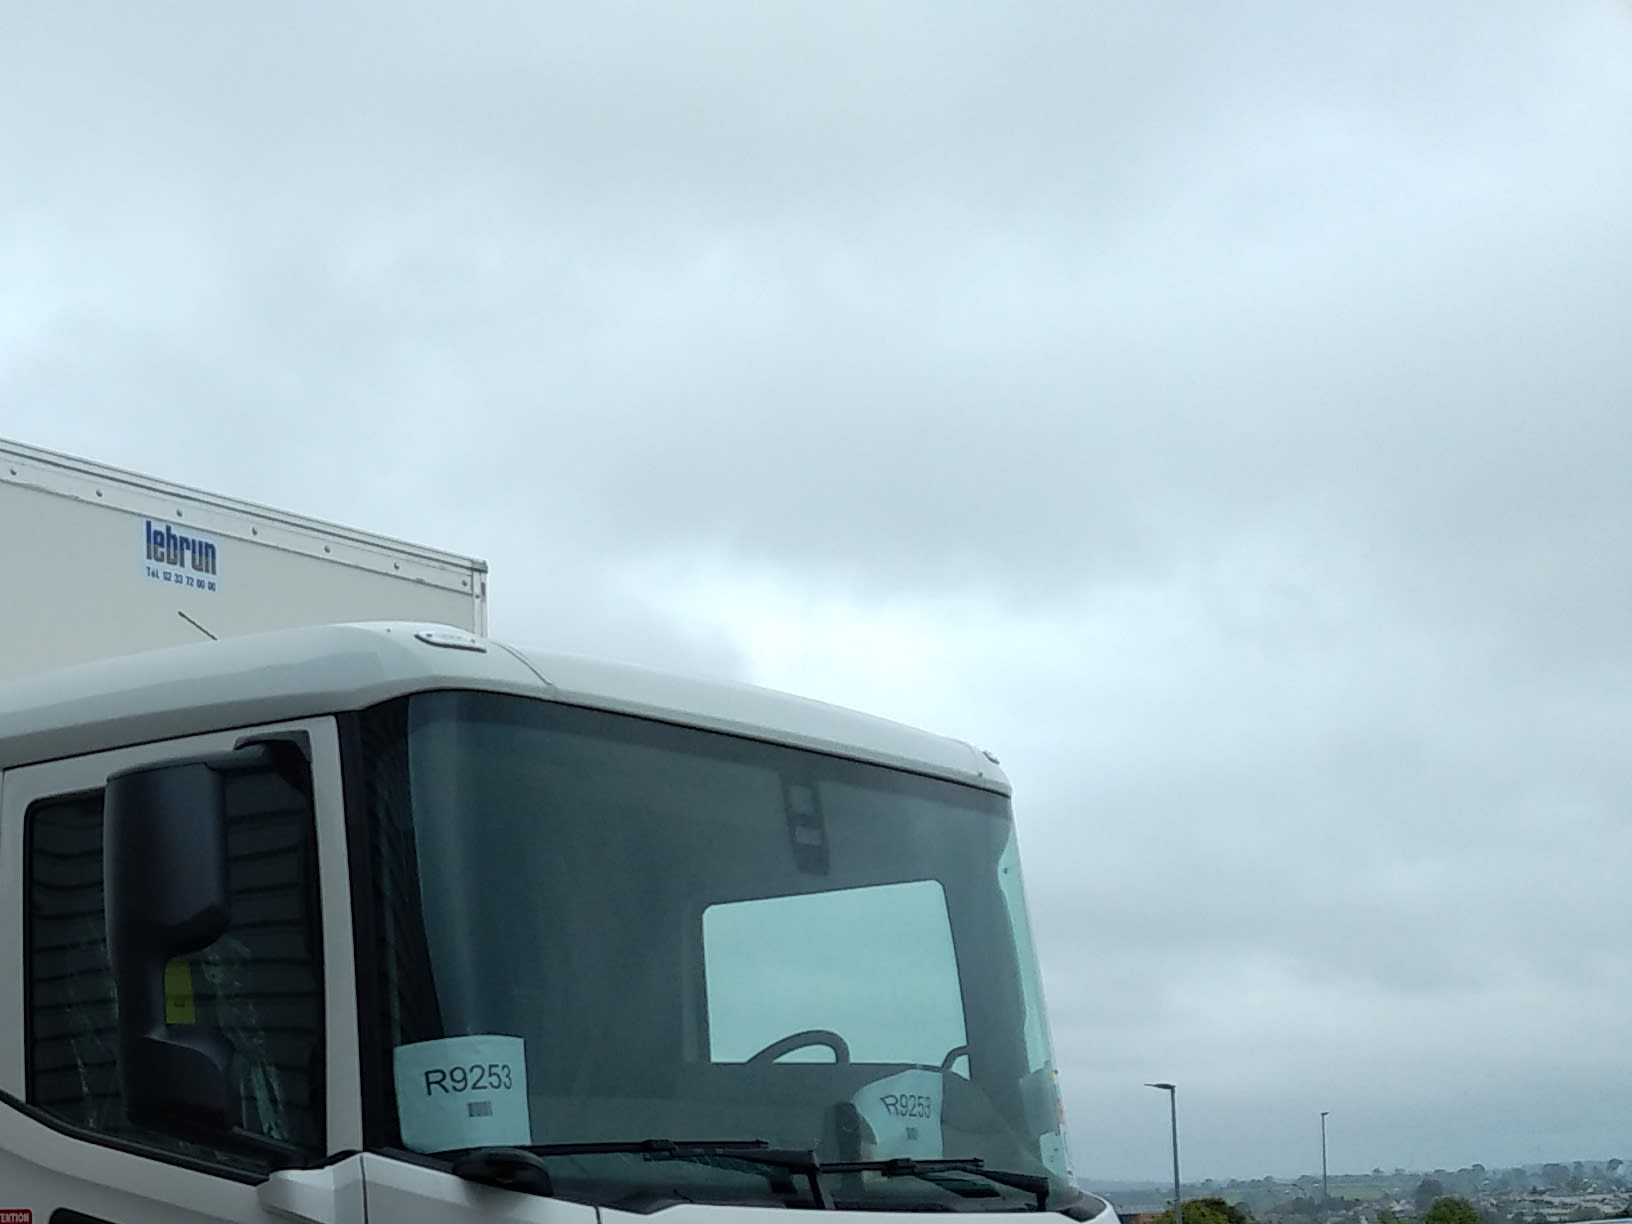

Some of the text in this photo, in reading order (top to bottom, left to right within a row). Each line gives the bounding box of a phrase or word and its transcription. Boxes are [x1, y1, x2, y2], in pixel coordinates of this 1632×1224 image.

[145, 519, 217, 576] lebrun
[424, 1064, 513, 1097] R9253
[879, 1093, 932, 1119] R9253
